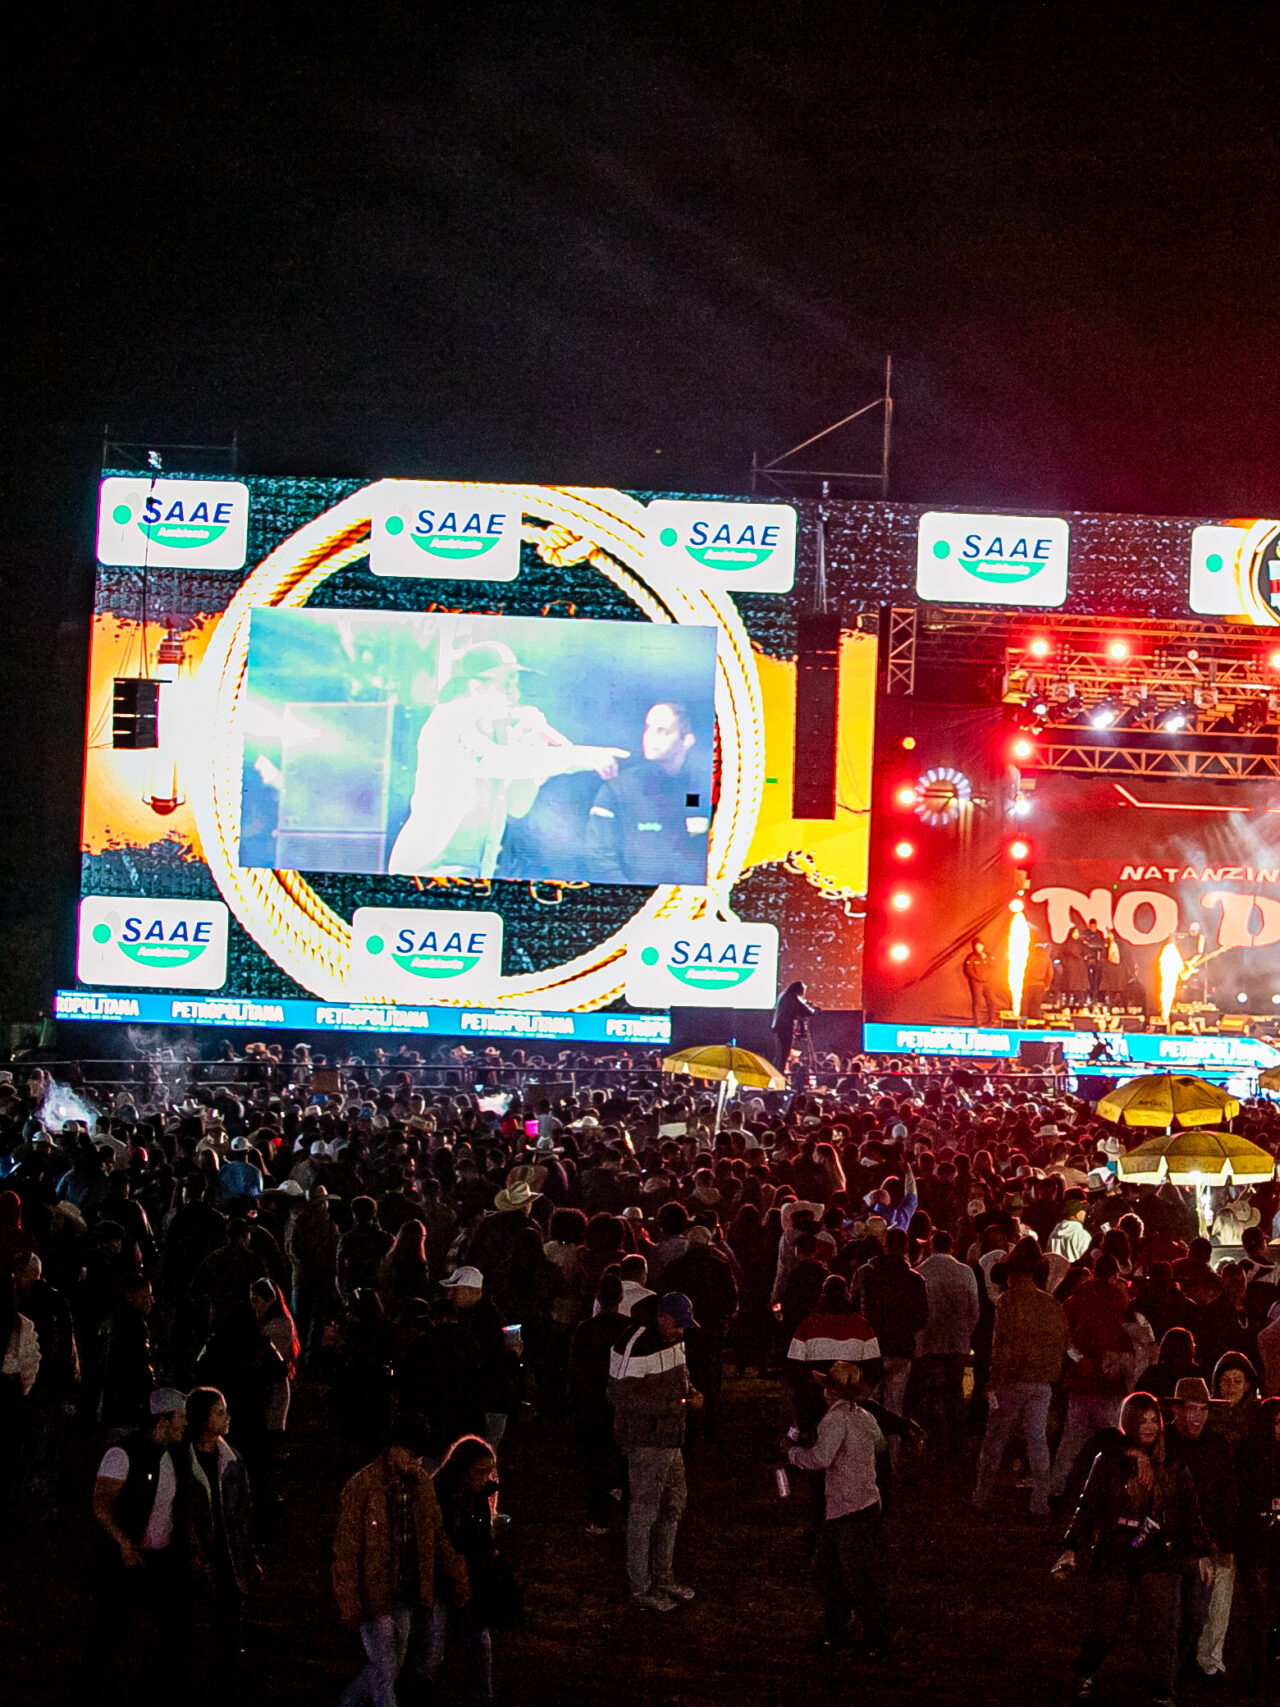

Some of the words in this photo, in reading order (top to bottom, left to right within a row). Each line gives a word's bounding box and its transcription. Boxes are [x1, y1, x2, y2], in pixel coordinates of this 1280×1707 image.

[141, 499, 233, 524] SAAE
[415, 509, 505, 535] SAAE
[689, 521, 780, 547] SAAE
[962, 534, 1052, 560] SAAE
[1031, 887, 1179, 945] NO
[122, 917, 213, 943] SAAE
[395, 928, 487, 954] SAAE
[671, 940, 761, 965] SAAE
